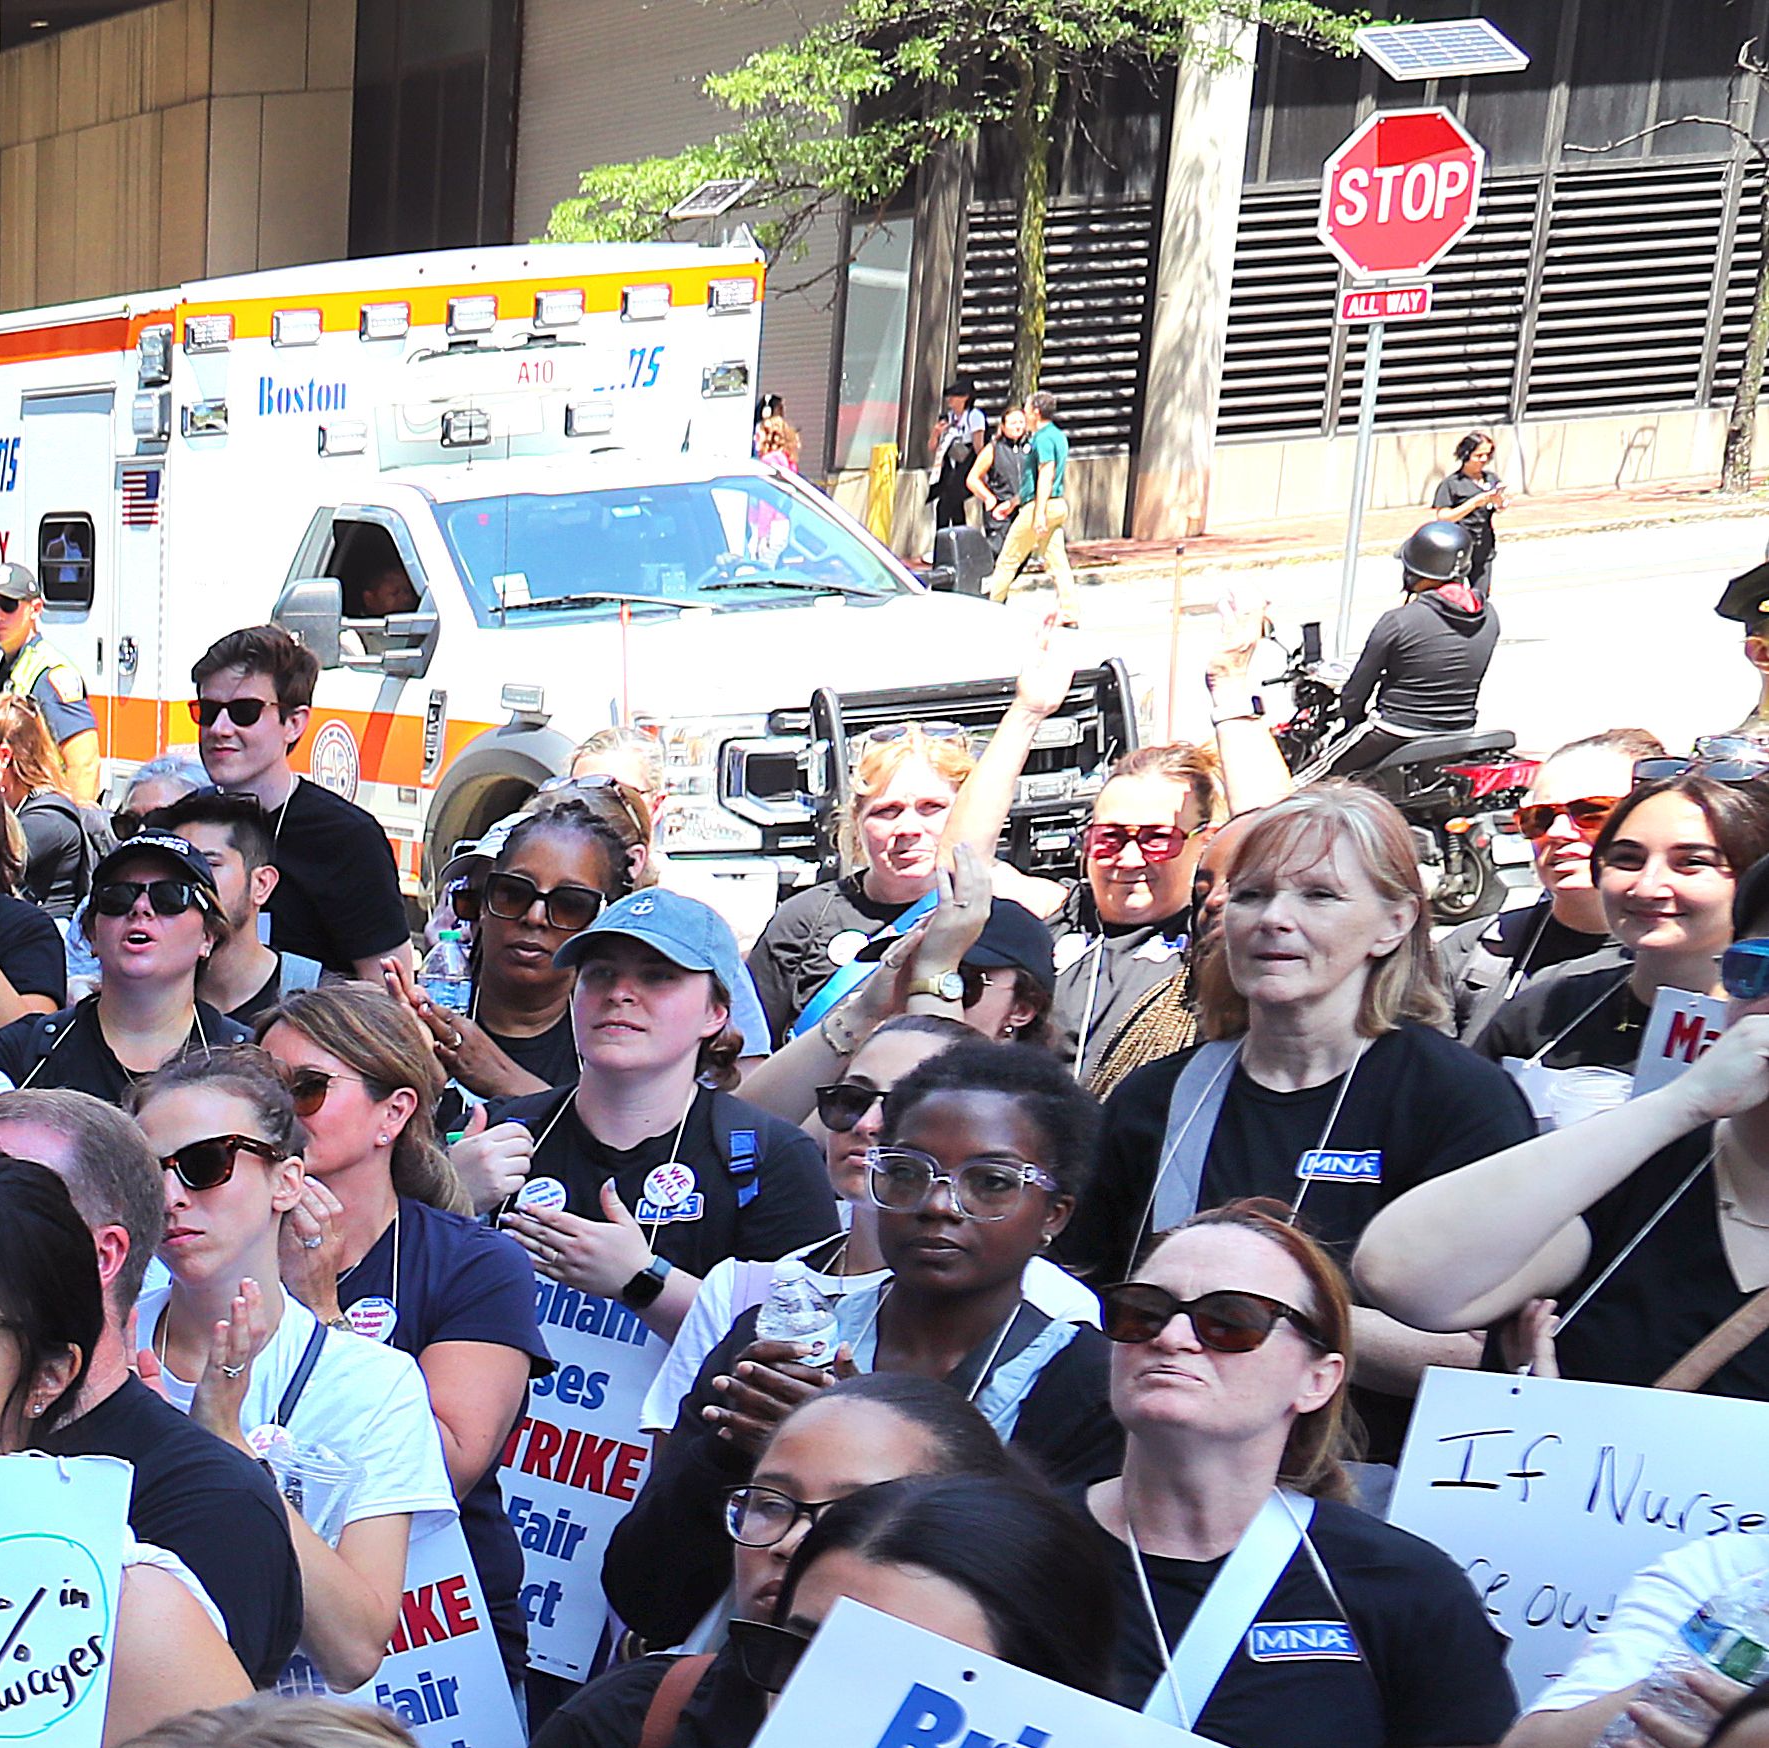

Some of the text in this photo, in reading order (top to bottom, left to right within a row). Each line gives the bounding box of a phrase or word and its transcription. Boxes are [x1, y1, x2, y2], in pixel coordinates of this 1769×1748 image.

[1335, 160, 1469, 227] STOP
[1347, 291, 1424, 316] ALL WAY
[517, 360, 554, 385] A10
[259, 375, 348, 416] Boston
[653, 1169, 681, 1204] WILL
[668, 1165, 691, 1190] WE
[500, 1416, 649, 1502] TRIKE
[1430, 1428, 1562, 1504] If
[508, 1495, 588, 1562] Fair
[59, 1579, 90, 1610] in
[1255, 1628, 1350, 1654] MNA
